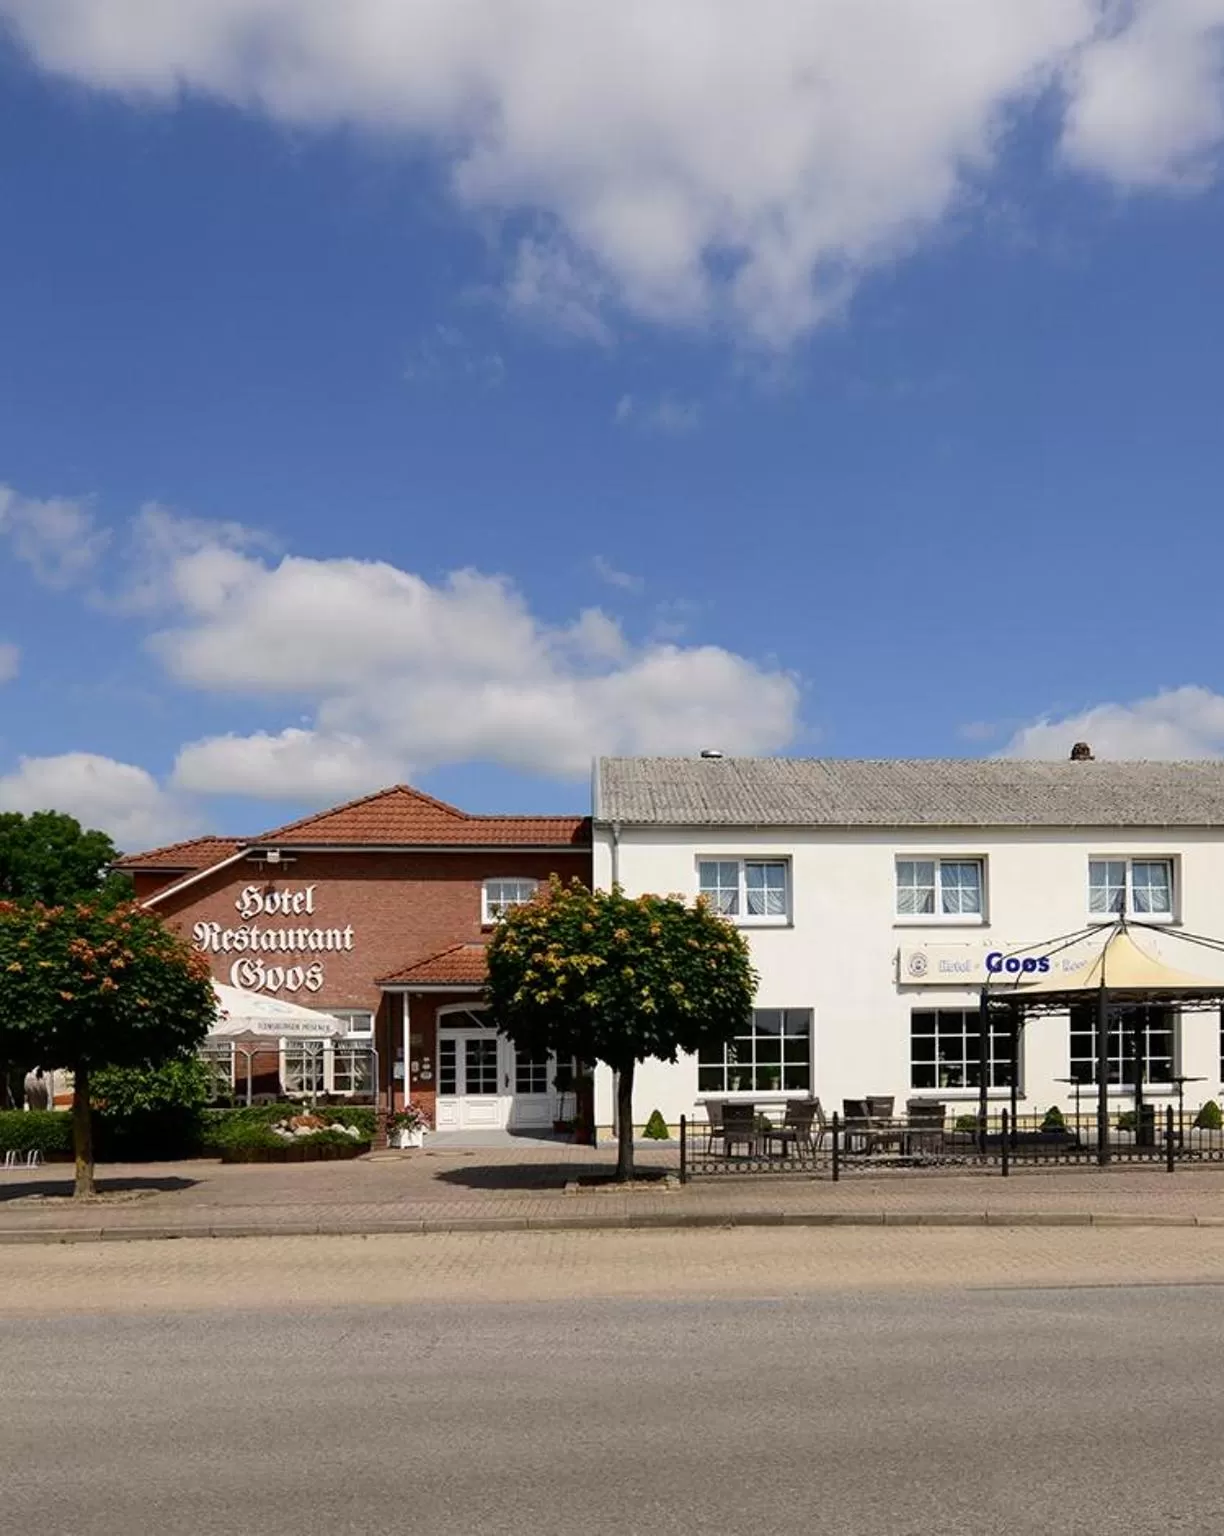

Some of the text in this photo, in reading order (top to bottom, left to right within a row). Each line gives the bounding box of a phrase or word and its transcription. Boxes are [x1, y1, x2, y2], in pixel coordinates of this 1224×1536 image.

[235, 884, 318, 920] Hotel
[192, 921, 355, 952] Restaurant
[230, 957, 324, 994] Goos
[985, 952, 1050, 974] Goos
